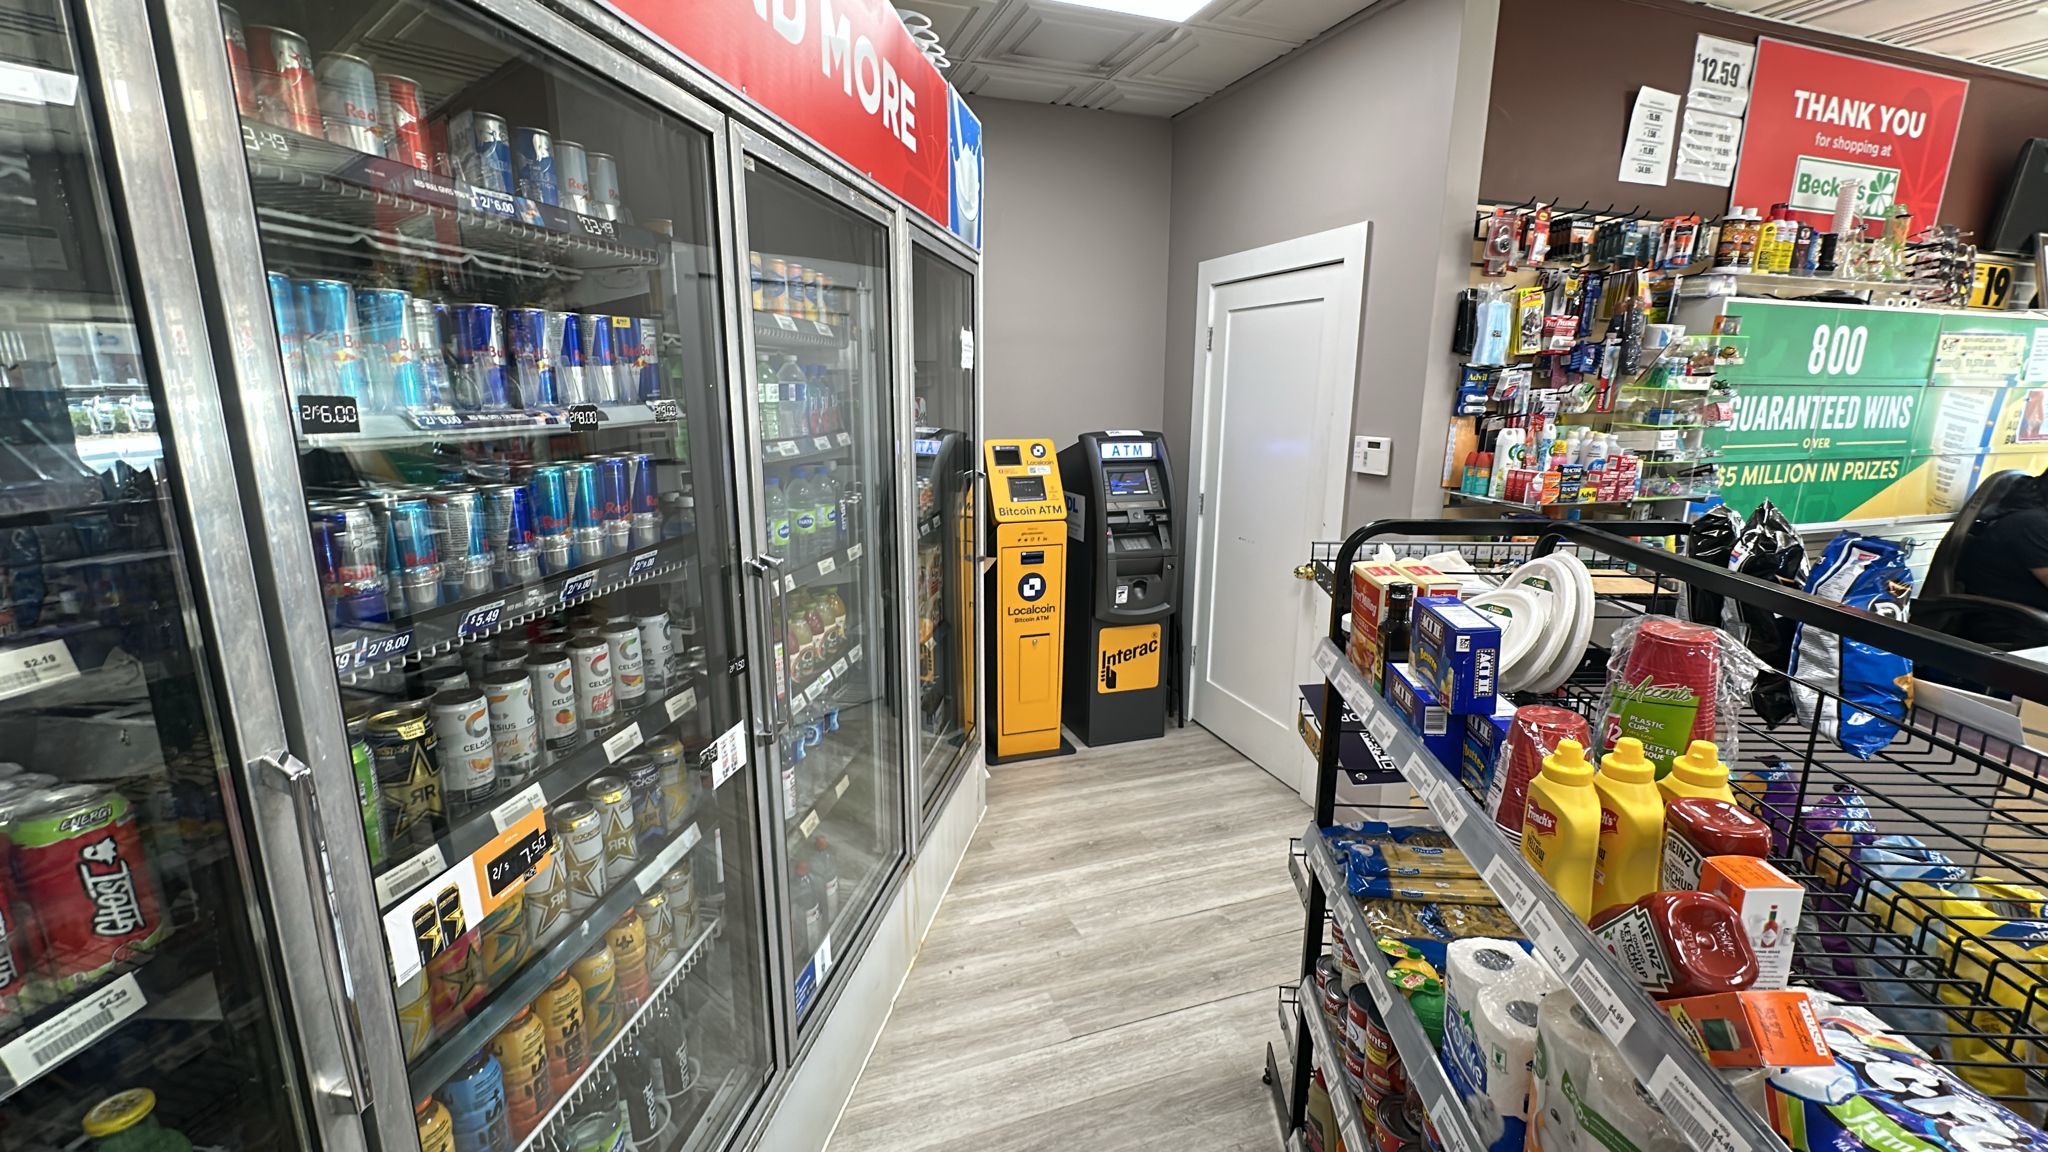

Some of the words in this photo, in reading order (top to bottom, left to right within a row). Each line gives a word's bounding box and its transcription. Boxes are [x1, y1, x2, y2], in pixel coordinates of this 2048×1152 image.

[820, 0, 918, 154] MORE
[1697, 53, 1741, 88] $12.59
[1793, 90, 1874, 131] THANK
[1877, 107, 1927, 139] YOU
[1815, 132, 1831, 149] for
[1832, 135, 1880, 158] shopping
[1881, 143, 1892, 157] at
[1808, 324, 1868, 375] 800
[1467, 373, 1488, 382] Advil
[1725, 395, 1861, 432] GUARANTEED
[1863, 394, 1914, 429] WINS
[1112, 445, 1143, 456] ATM
[1803, 437, 1831, 449] OVER
[1716, 465, 1738, 489] $5
[1740, 463, 1818, 487] MILLION
[1820, 463, 1837, 482] IN
[1842, 460, 1900, 482] PRIZES
[998, 507, 1036, 516] Bitcoin
[1039, 505, 1062, 515] ATM
[470, 609, 500, 628] $5.49
[1007, 603, 1056, 618] Localcoin
[1014, 615, 1035, 624] Bitcoin
[1035, 614, 1050, 622] ATM
[367, 634, 410, 658] 2/$8.00
[1101, 639, 1159, 669] Interac
[1479, 652, 1492, 676] ACT
[1628, 675, 1695, 703] Accents
[1606, 722, 1623, 743] 12
[1628, 722, 1651, 733] CUPS
[1629, 714, 1665, 730] PLASTIC
[1665, 748, 1678, 757] EN
[60, 805, 114, 834] ENERGY
[1527, 803, 1553, 828] French's
[519, 834, 548, 865] 7.50
[1527, 834, 1545, 862] YELLOW
[1667, 838, 1693, 868] HEINZ
[80, 860, 148, 937] GHOST
[1622, 921, 1648, 980] KETCHUP
[1631, 933, 1646, 964] TOMATO
[1639, 920, 1661, 971] HEINZ
[1607, 1004, 1625, 1025] $4.99
[1799, 1000, 1828, 1056] TABASCO
[676, 1040, 691, 1090] smart
[642, 1081, 658, 1130] smart
